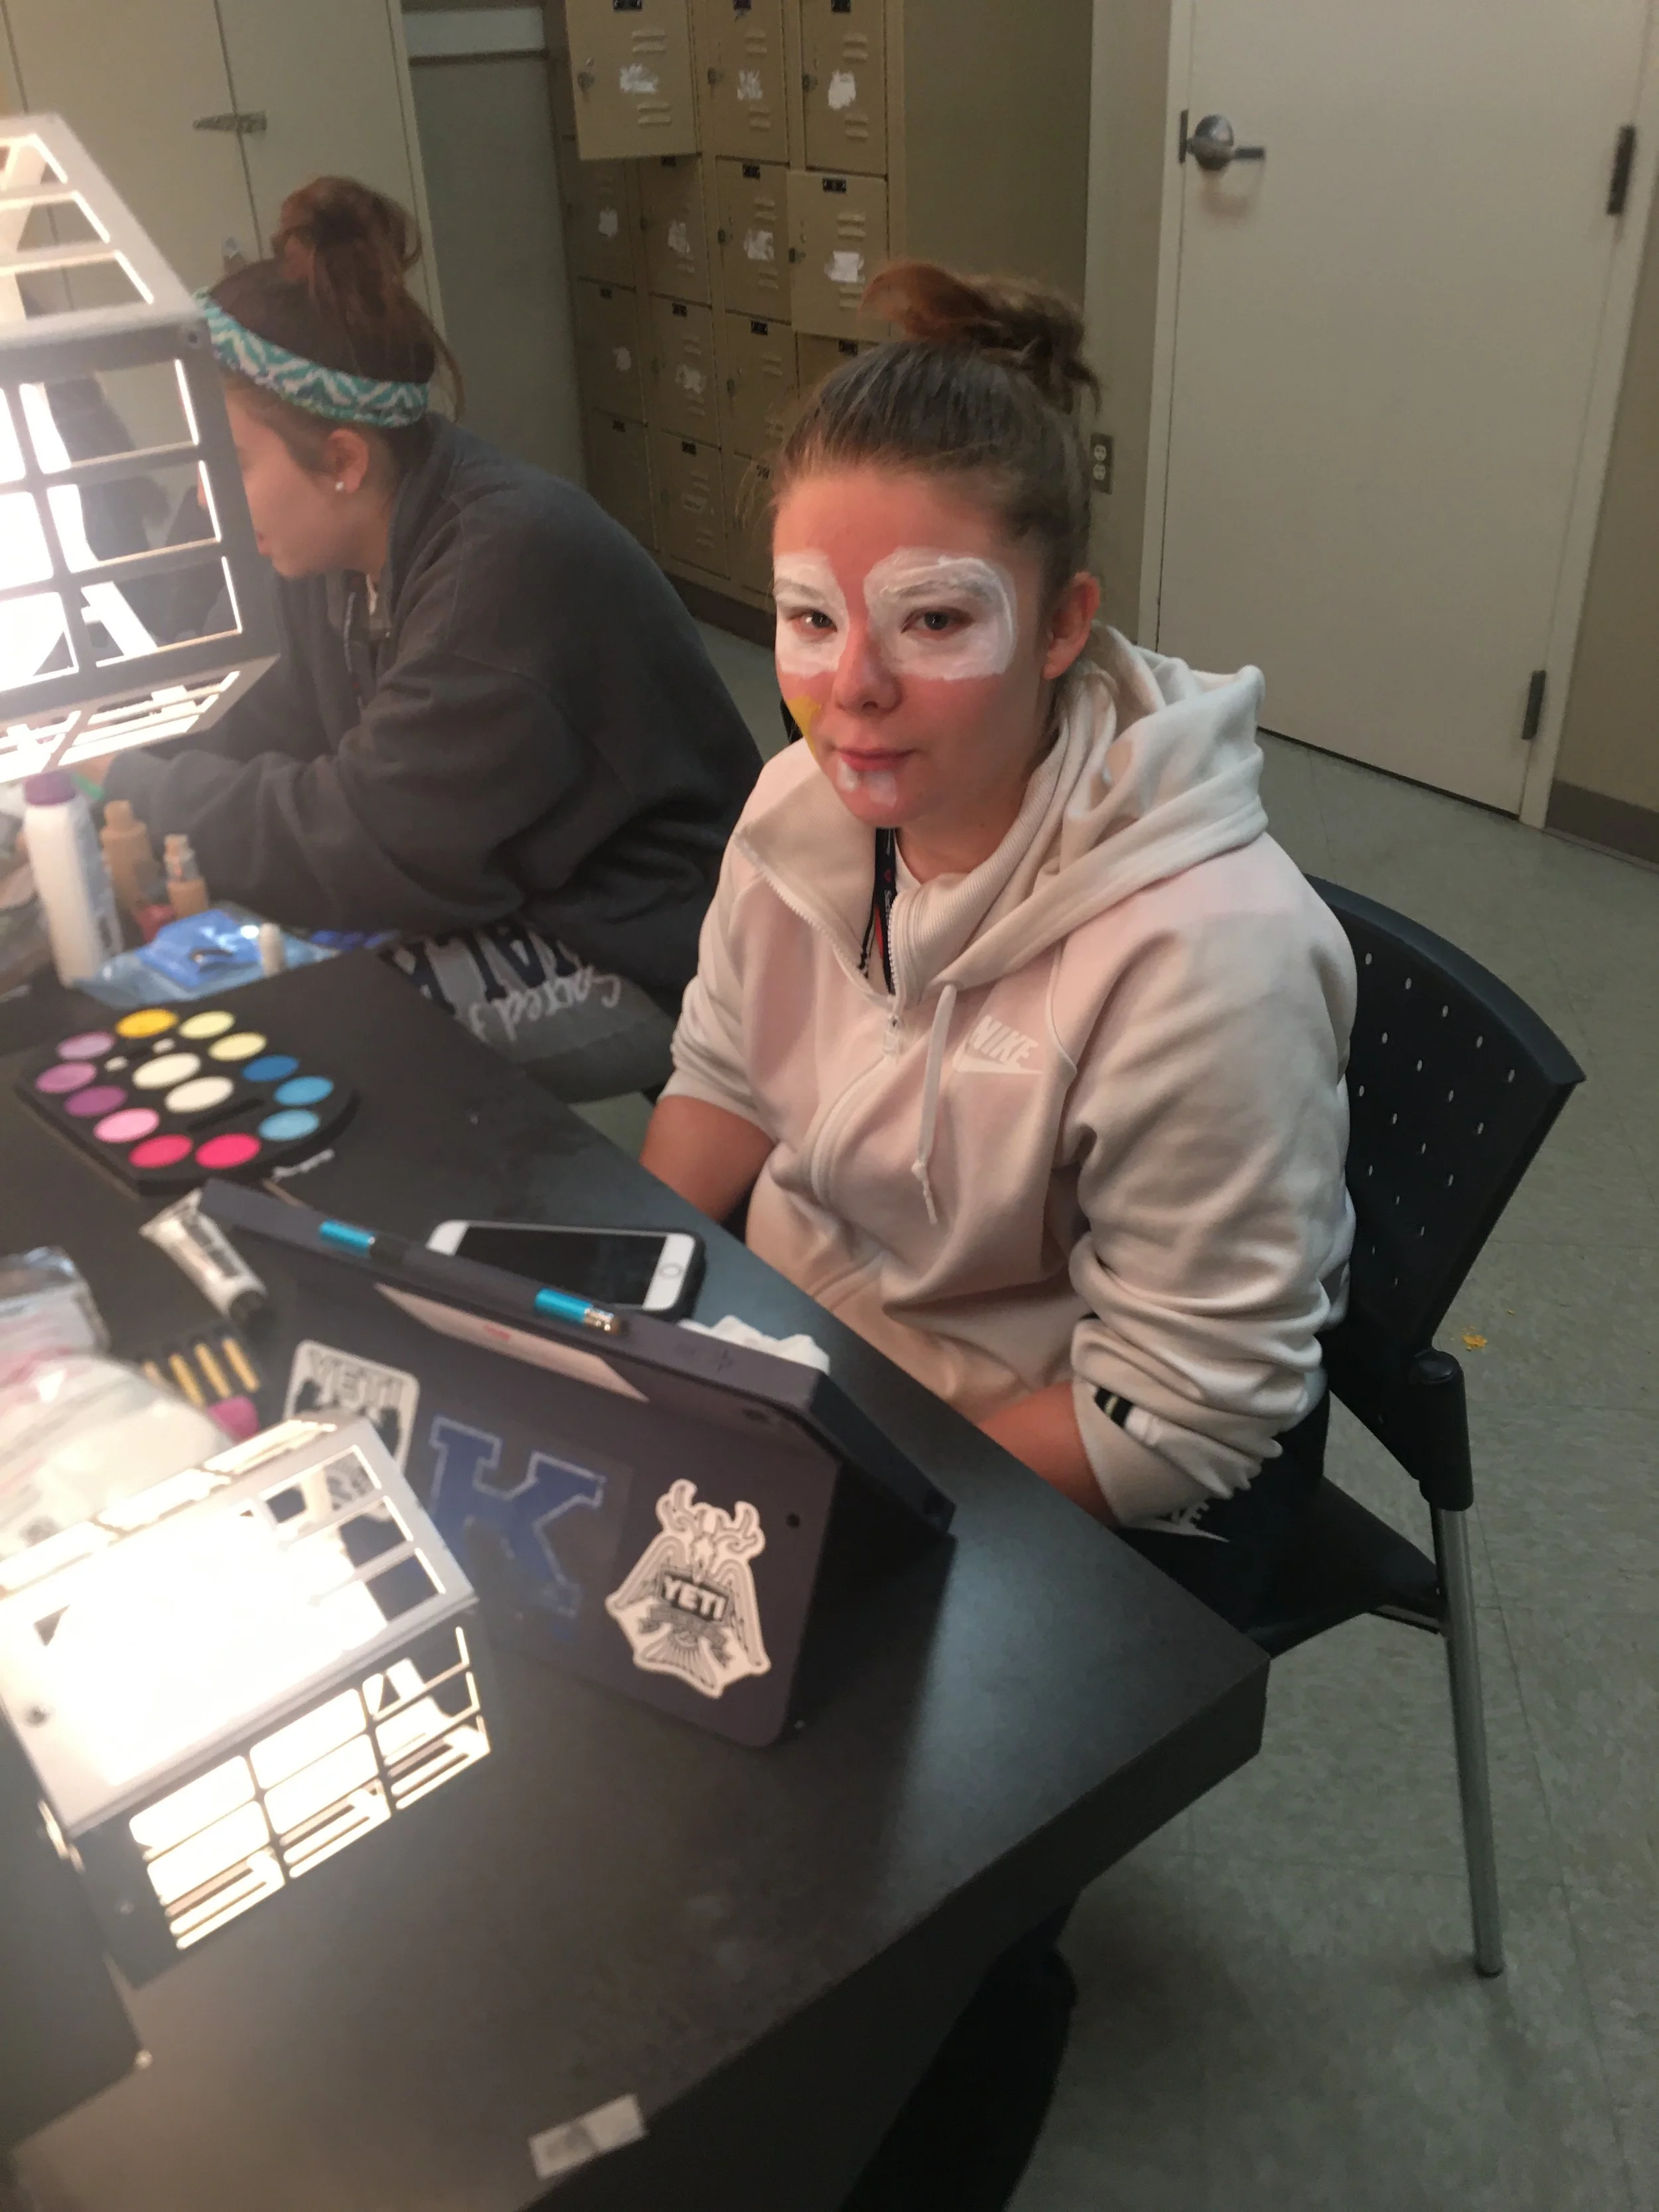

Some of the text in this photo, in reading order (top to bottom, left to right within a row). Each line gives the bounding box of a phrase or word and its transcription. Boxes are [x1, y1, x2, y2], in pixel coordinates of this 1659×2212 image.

[973, 1014, 1039, 1069] NIKE
[428, 1415, 607, 1618] K
[664, 1574, 727, 1620] YETI
